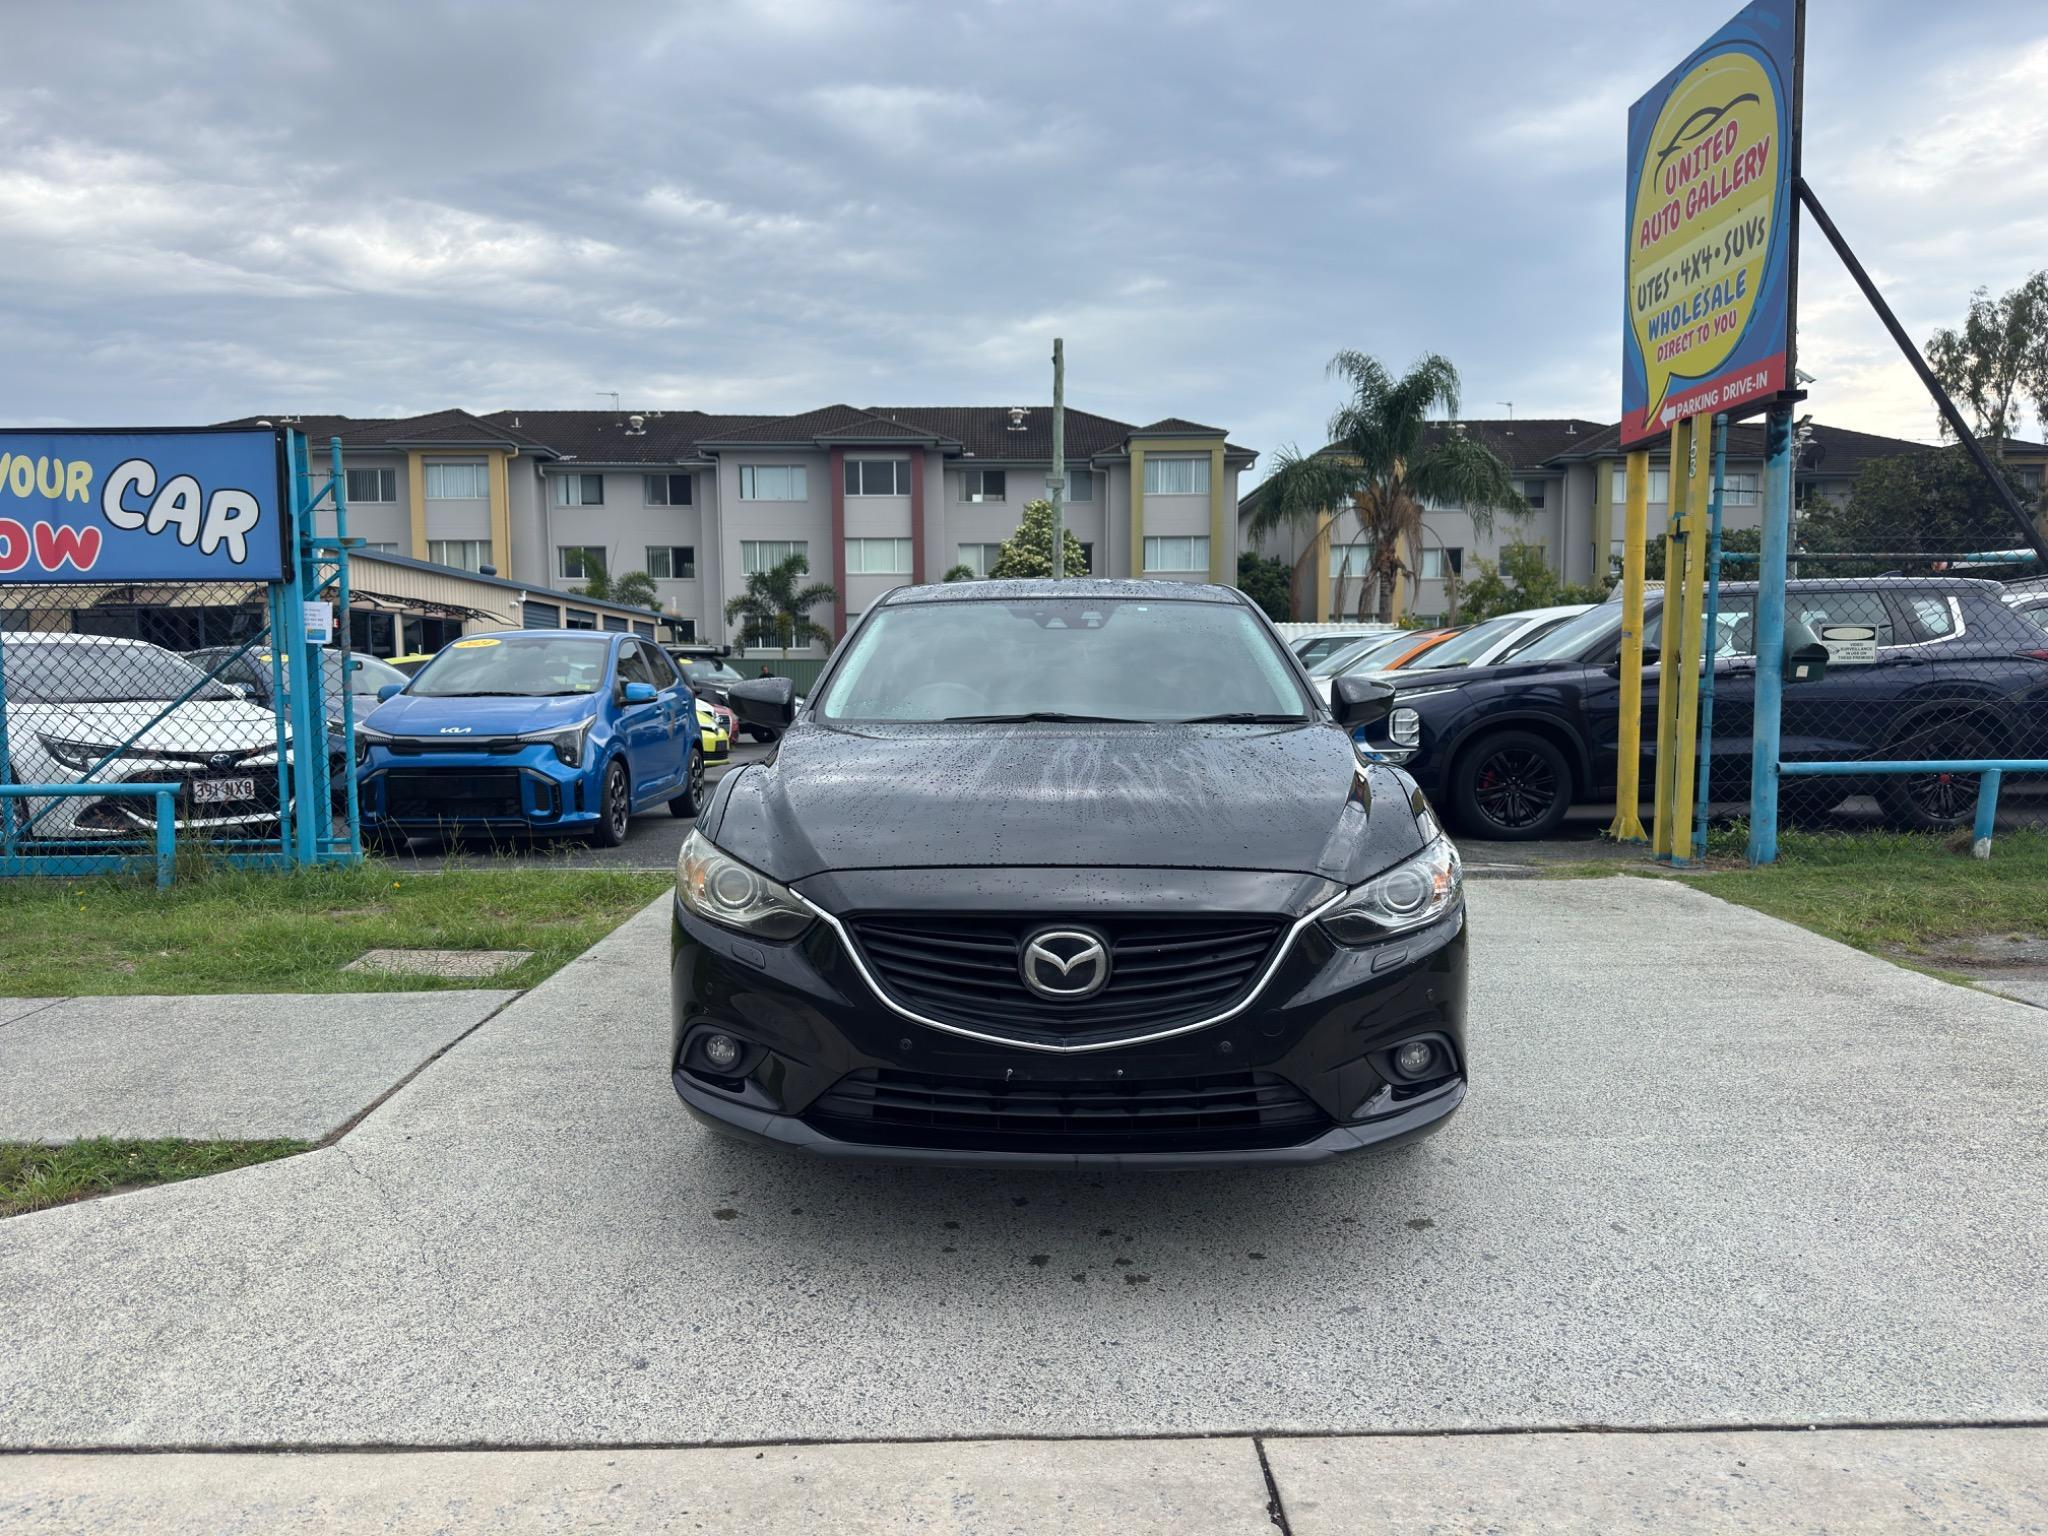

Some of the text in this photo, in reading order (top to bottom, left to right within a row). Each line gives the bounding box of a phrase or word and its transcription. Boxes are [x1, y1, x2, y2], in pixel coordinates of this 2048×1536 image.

[1640, 135, 1770, 249] AUTO GALLERY
[1665, 120, 1738, 195] UNITED
[1637, 267, 1670, 312] UTES
[1680, 245, 1712, 286] 4X4
[1647, 268, 1746, 342] WHOLESALE
[1656, 309, 1737, 363] DIRECT TO YOU
[1676, 370, 1768, 418] PARKING DRIVE-IN
[101, 457, 260, 564] CAR
